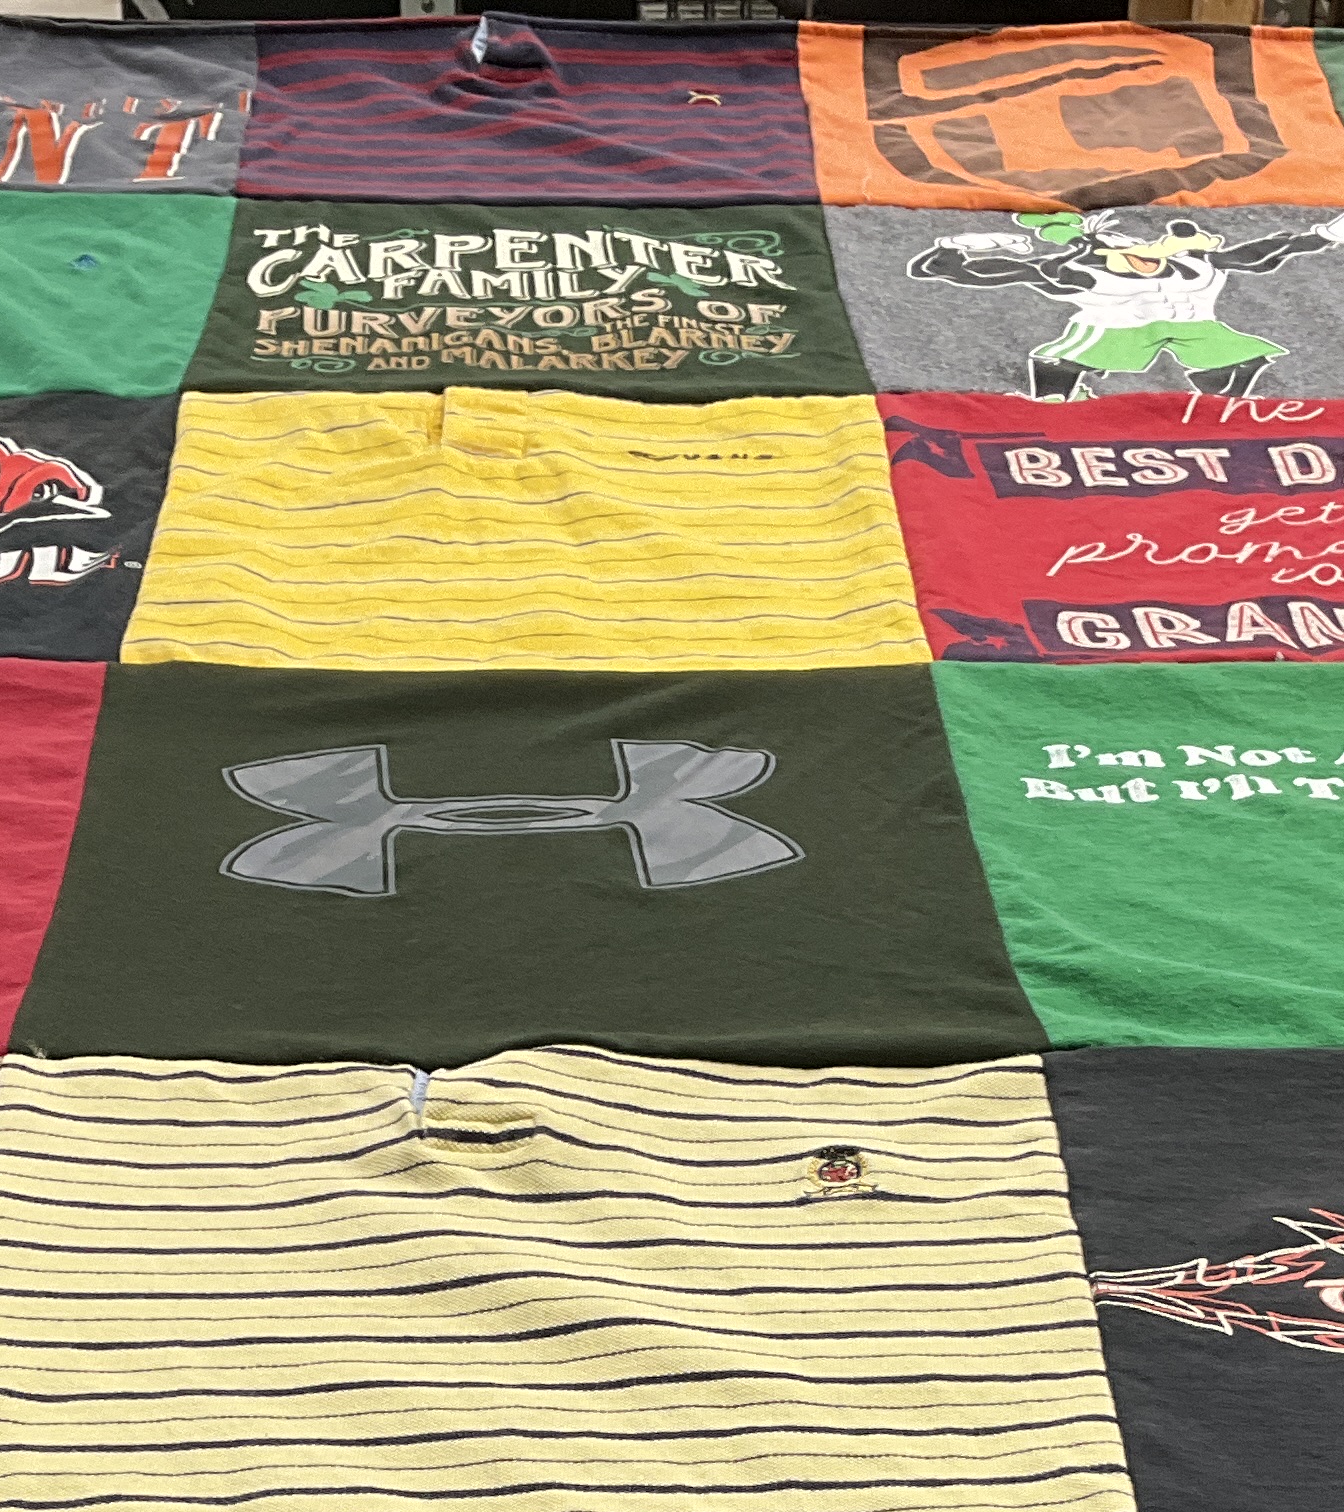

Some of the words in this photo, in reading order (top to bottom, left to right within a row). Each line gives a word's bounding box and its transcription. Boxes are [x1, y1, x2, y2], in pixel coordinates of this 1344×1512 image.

[254, 223, 360, 249] THE
[247, 229, 797, 297] CARPENTER
[381, 264, 647, 301] FAMILY
[258, 288, 672, 336] PURVEYORS
[697, 300, 788, 325] OF
[603, 314, 651, 332] THE
[656, 316, 746, 336] FINEST
[592, 331, 797, 355] BLARNEY
[366, 355, 431, 371] AND
[441, 345, 691, 371] MALARKEY
[1183, 391, 1324, 423] The
[1007, 446, 1229, 488] BEST
[1042, 743, 1166, 769] I'm
[1176, 744, 1316, 768] Not
[1019, 776, 1160, 804] But
